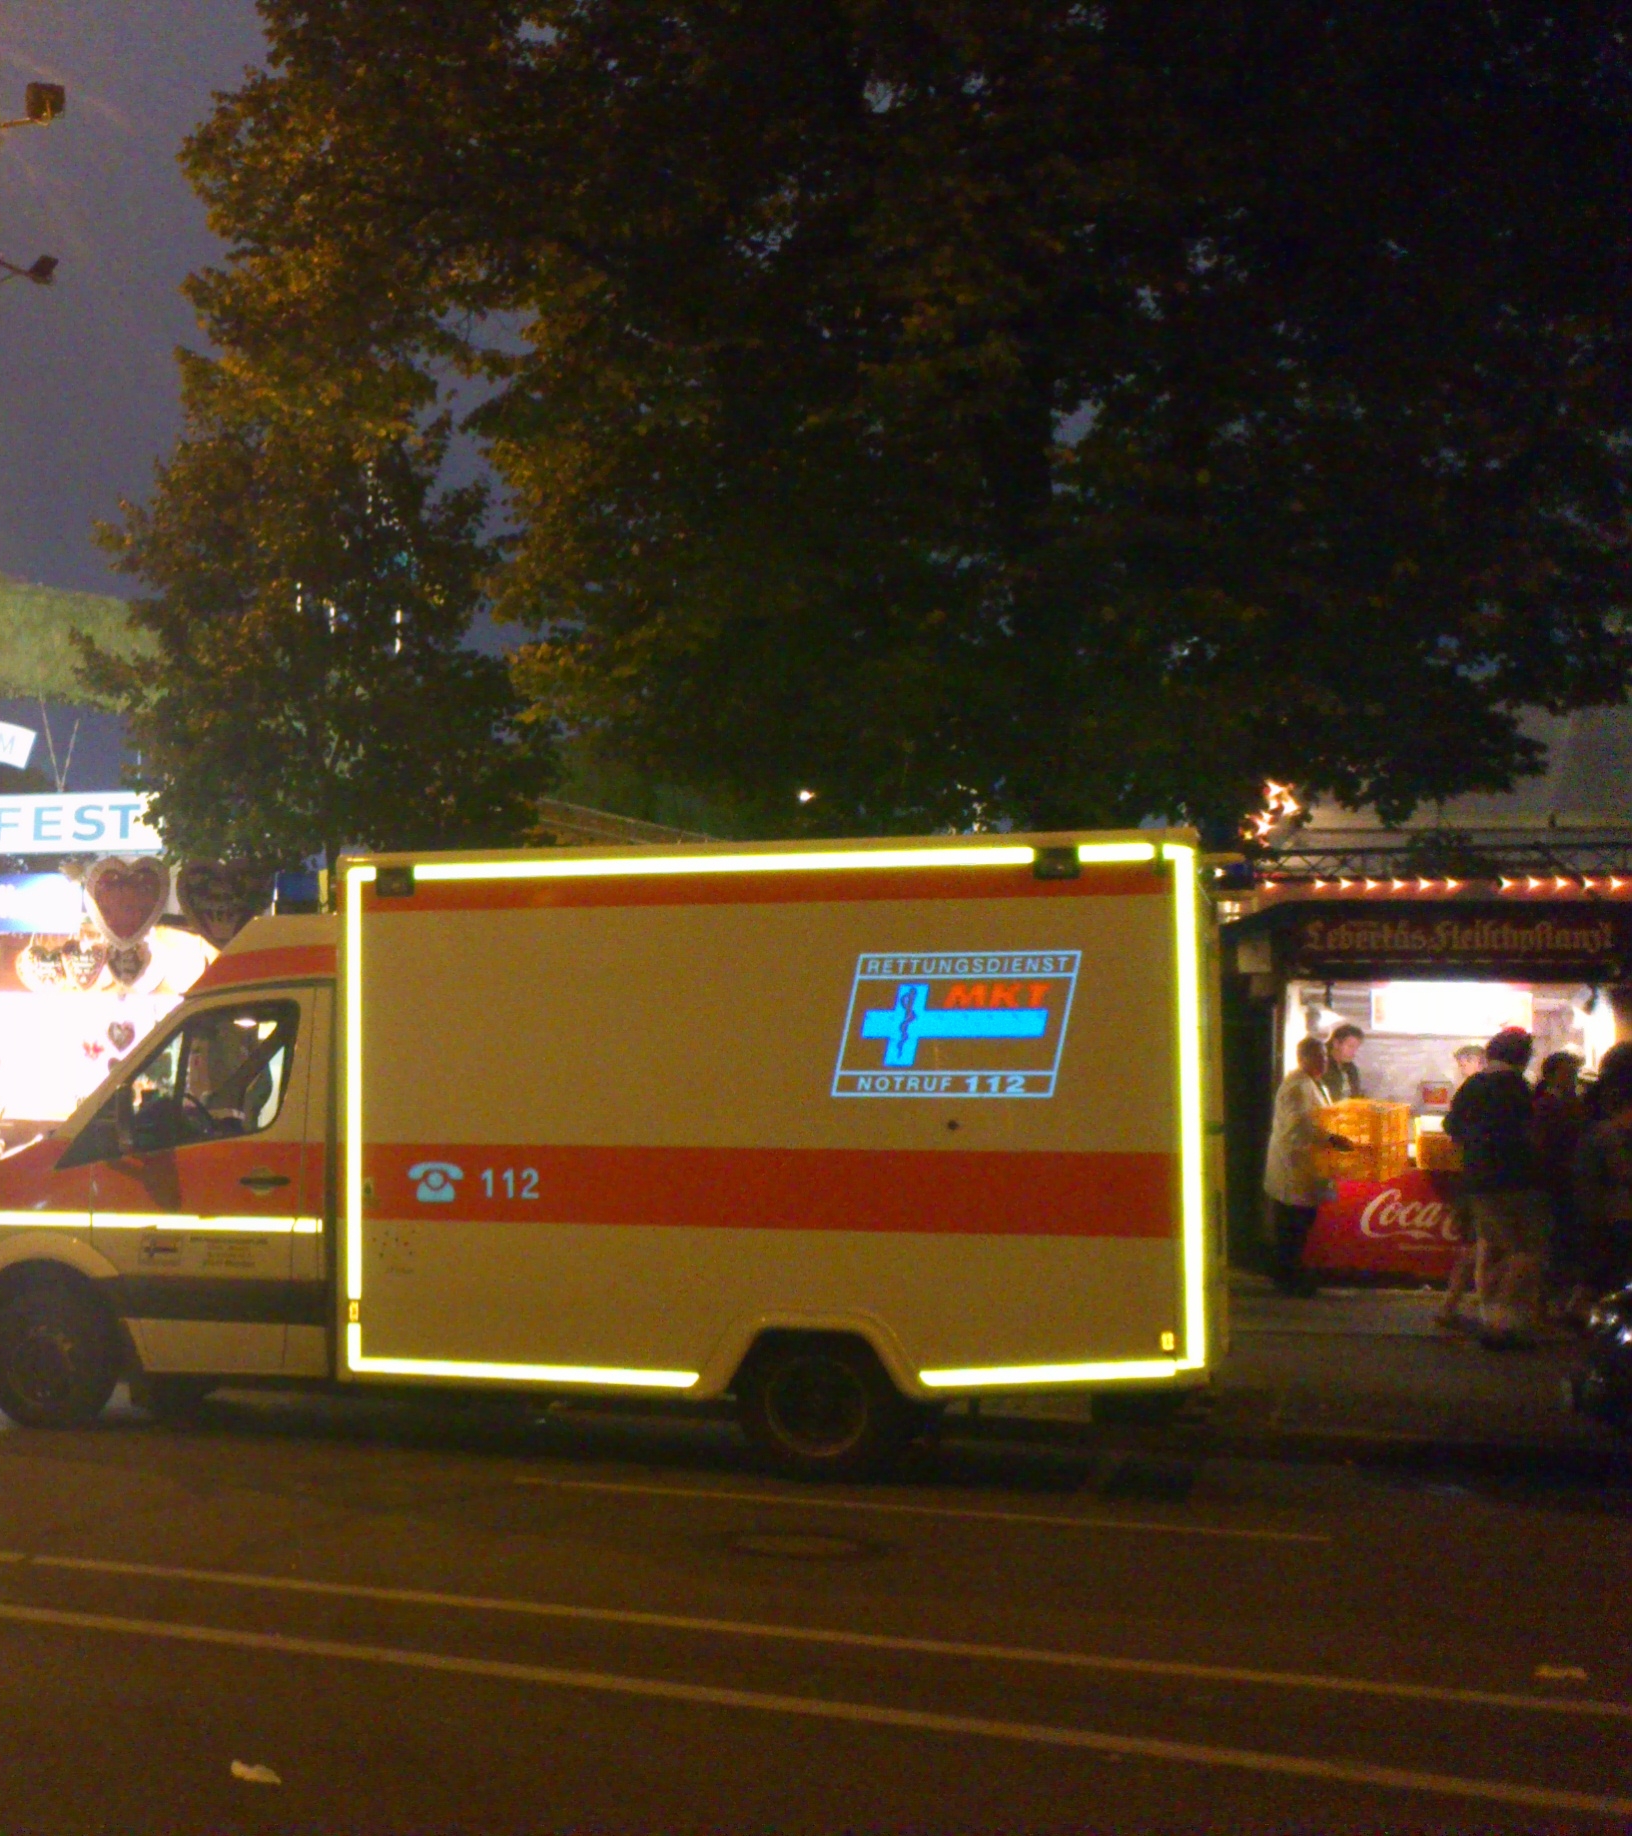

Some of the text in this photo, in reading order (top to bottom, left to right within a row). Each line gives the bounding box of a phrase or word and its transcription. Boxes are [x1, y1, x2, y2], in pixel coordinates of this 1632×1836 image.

[866, 956, 1069, 975] RETTUNGSDIENST
[943, 982, 1052, 1009] MKT
[857, 1075, 1026, 1093] NOTRUF 112
[480, 1167, 540, 1200] 112
